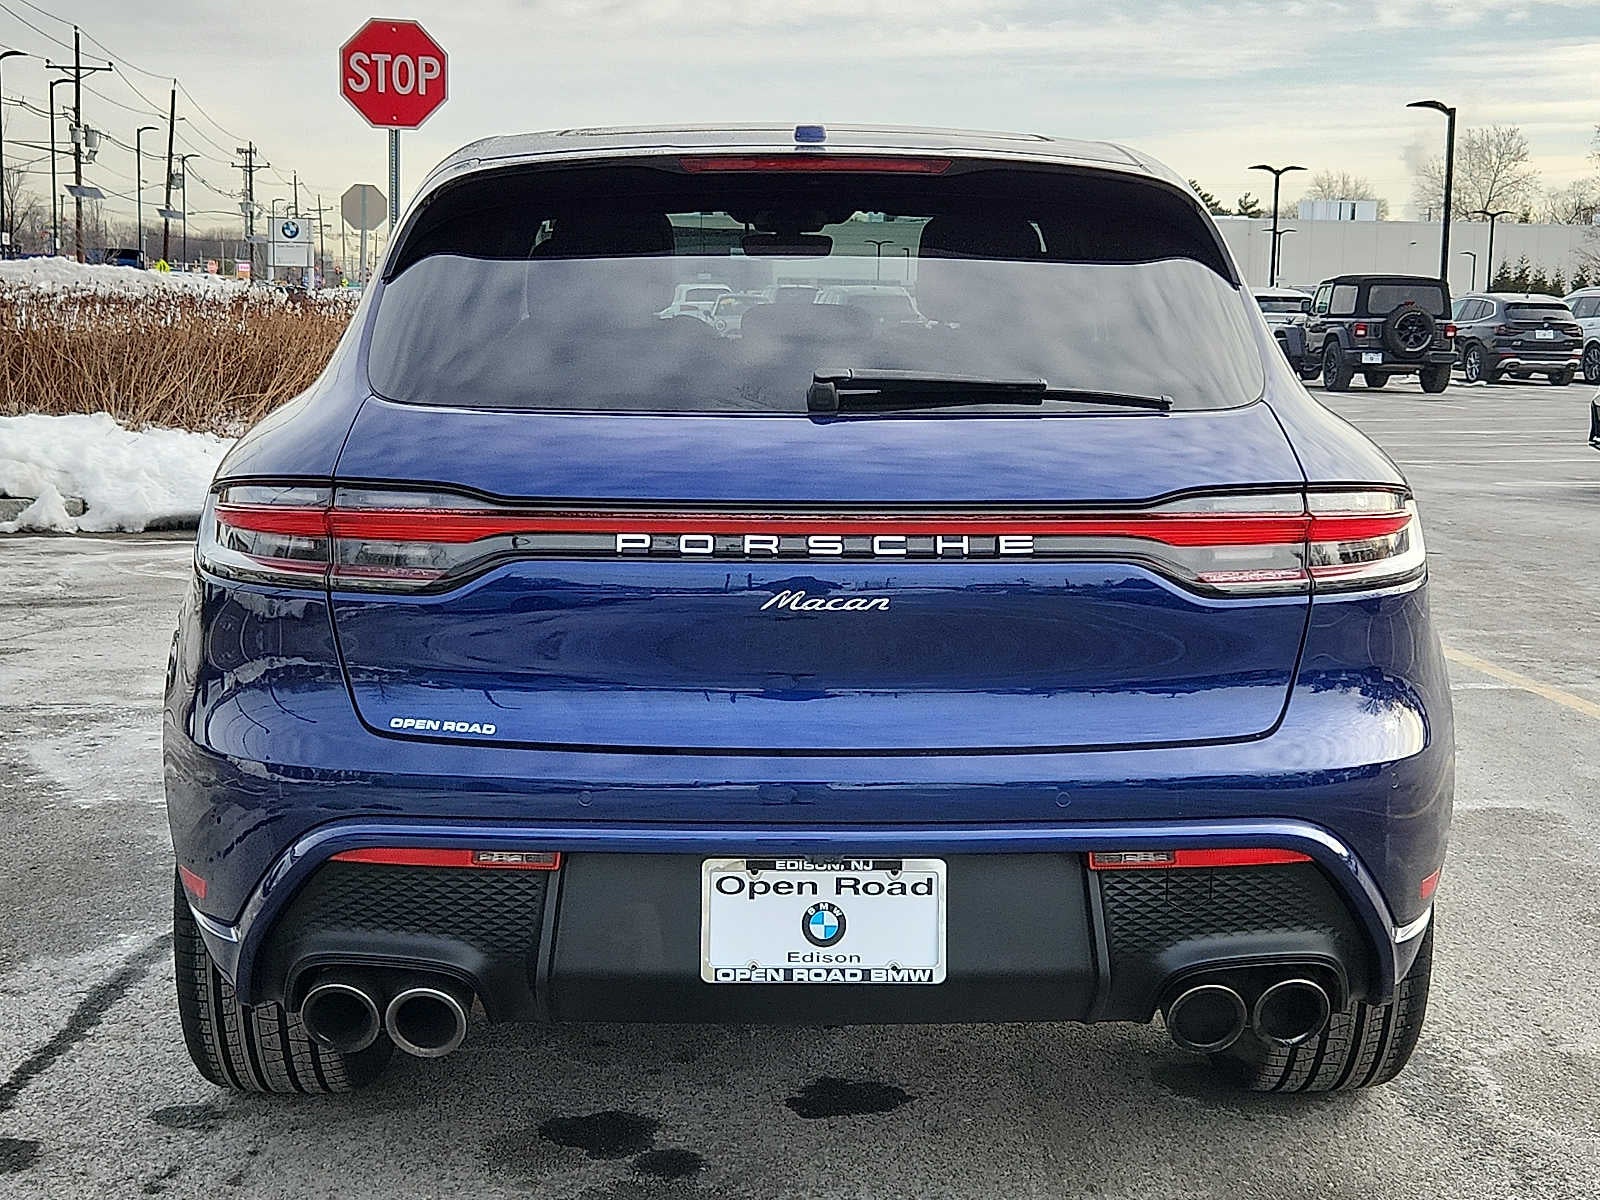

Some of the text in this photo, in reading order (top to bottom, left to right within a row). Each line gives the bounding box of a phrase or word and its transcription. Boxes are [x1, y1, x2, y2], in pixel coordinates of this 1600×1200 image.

[347, 51, 441, 95] STOP
[616, 533, 1035, 555] PORSCHE
[759, 590, 890, 612] Macan
[389, 717, 496, 735] OPEN ROAD
[851, 860, 874, 871] NJ
[715, 875, 933, 900] Open Road
[807, 902, 843, 917] BMW
[787, 952, 861, 964] Edison
[716, 968, 931, 982] OPEN ROAD BMW
